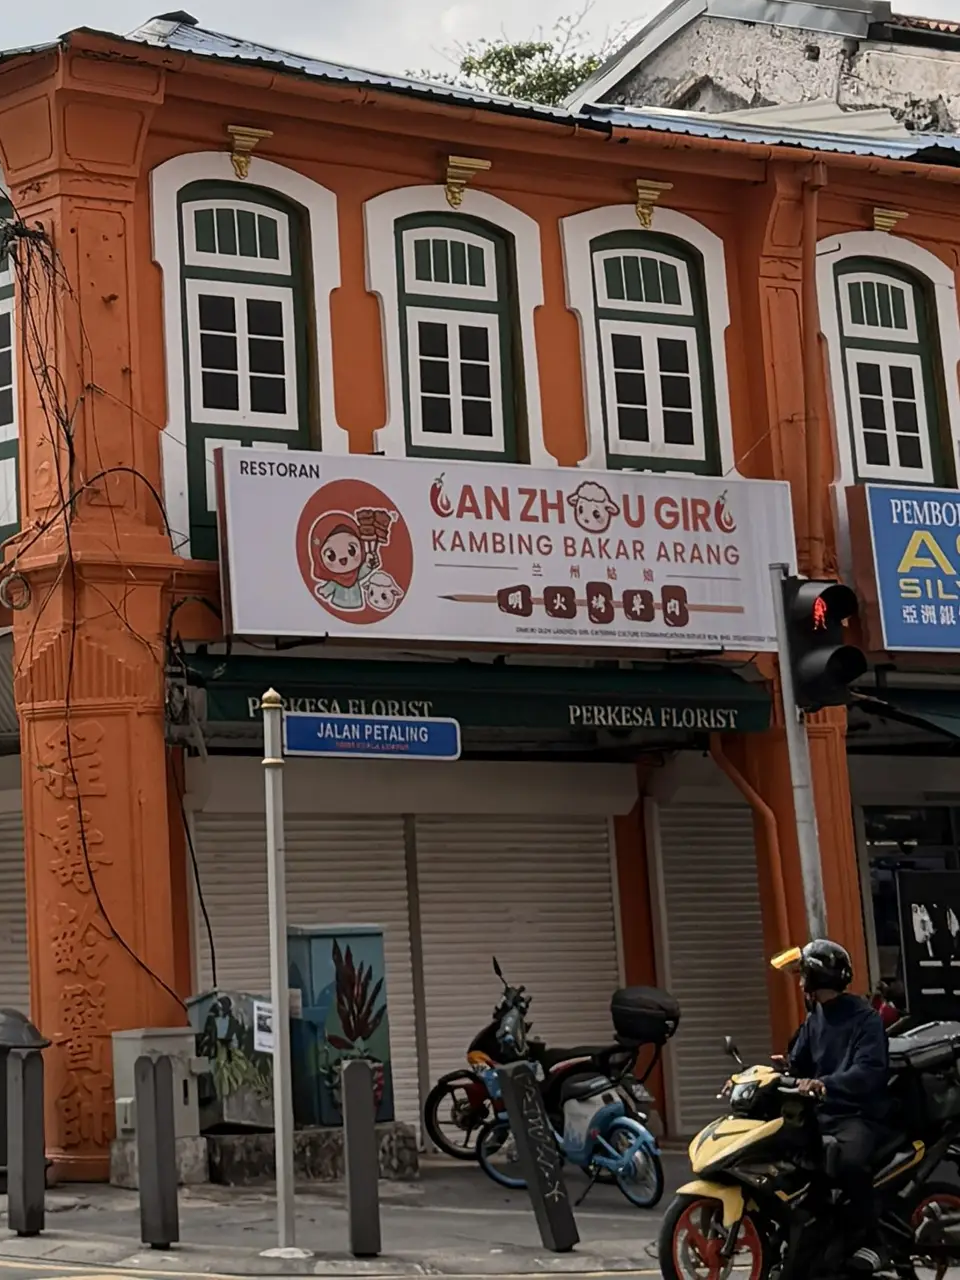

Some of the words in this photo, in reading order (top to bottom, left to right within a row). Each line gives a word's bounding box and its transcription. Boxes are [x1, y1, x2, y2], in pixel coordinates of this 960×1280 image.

[239, 460, 320, 479] RESTORAN
[432, 529, 553, 556] KAMBING
[563, 536, 645, 561] BAKAR
[656, 541, 740, 565] ARANG
[897, 530, 960, 575] A
[899, 578, 960, 600] SIL
[902, 604, 960, 625] 亞洲銀
[568, 704, 655, 727] PERKESA
[660, 707, 738, 729] FLORIST
[317, 722, 360, 740] JALAN
[365, 724, 429, 743] PETALING
